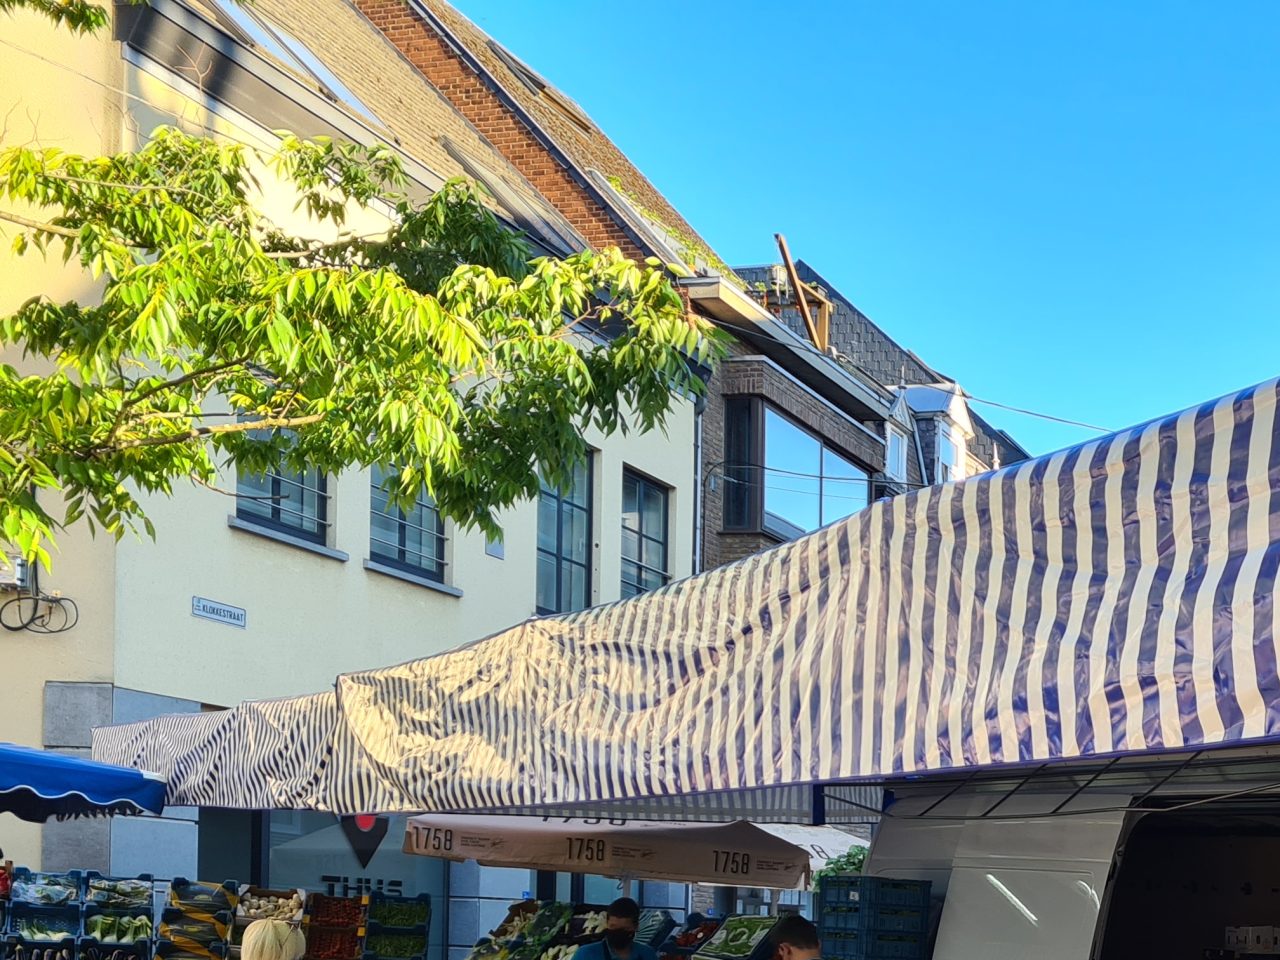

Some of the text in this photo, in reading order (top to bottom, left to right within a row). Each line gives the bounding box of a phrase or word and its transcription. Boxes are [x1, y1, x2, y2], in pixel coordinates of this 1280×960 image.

[413, 826, 453, 850] 1758
[566, 837, 606, 862] 1758
[713, 850, 750, 874] 1758
